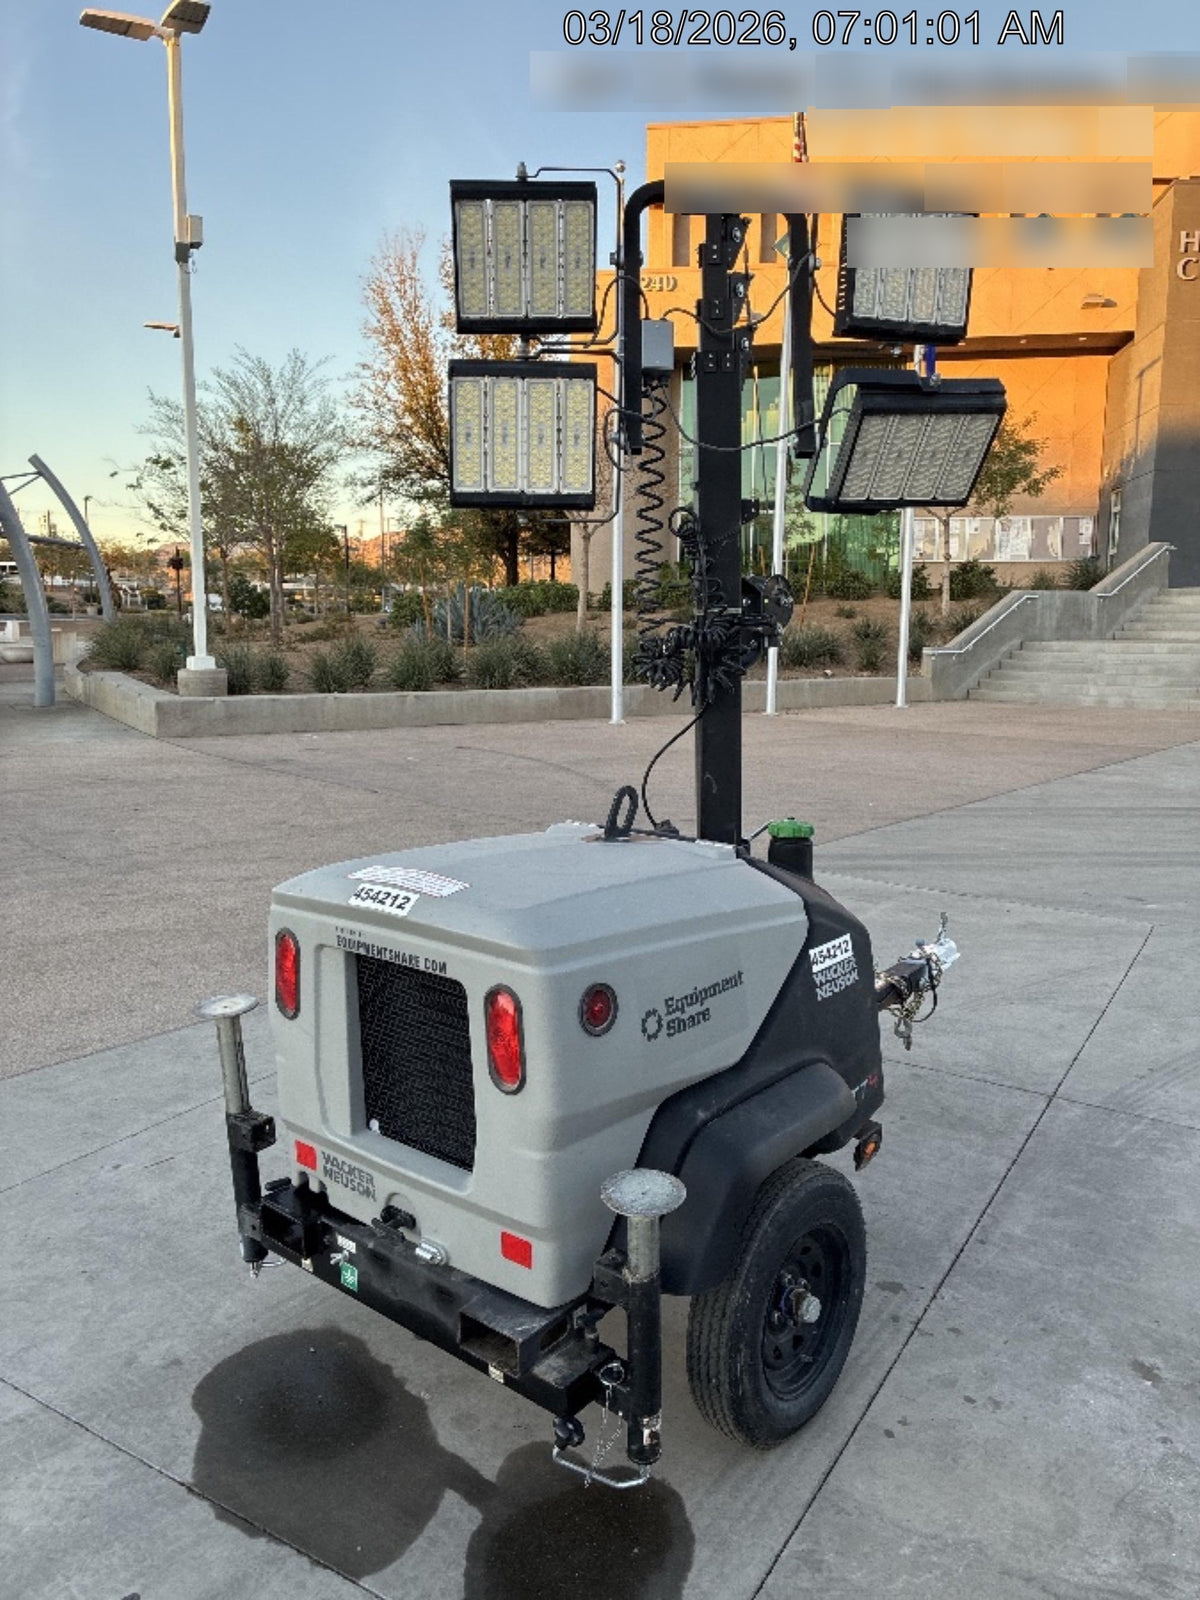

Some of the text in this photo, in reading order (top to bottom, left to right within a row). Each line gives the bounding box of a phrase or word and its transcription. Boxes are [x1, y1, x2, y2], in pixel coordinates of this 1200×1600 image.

[352, 886, 412, 911] 454212
[664, 969, 745, 1017] Equipment
[666, 1006, 712, 1039] Share
[321, 1150, 376, 1188] WACKER
[323, 1165, 377, 1203] NEUSON
